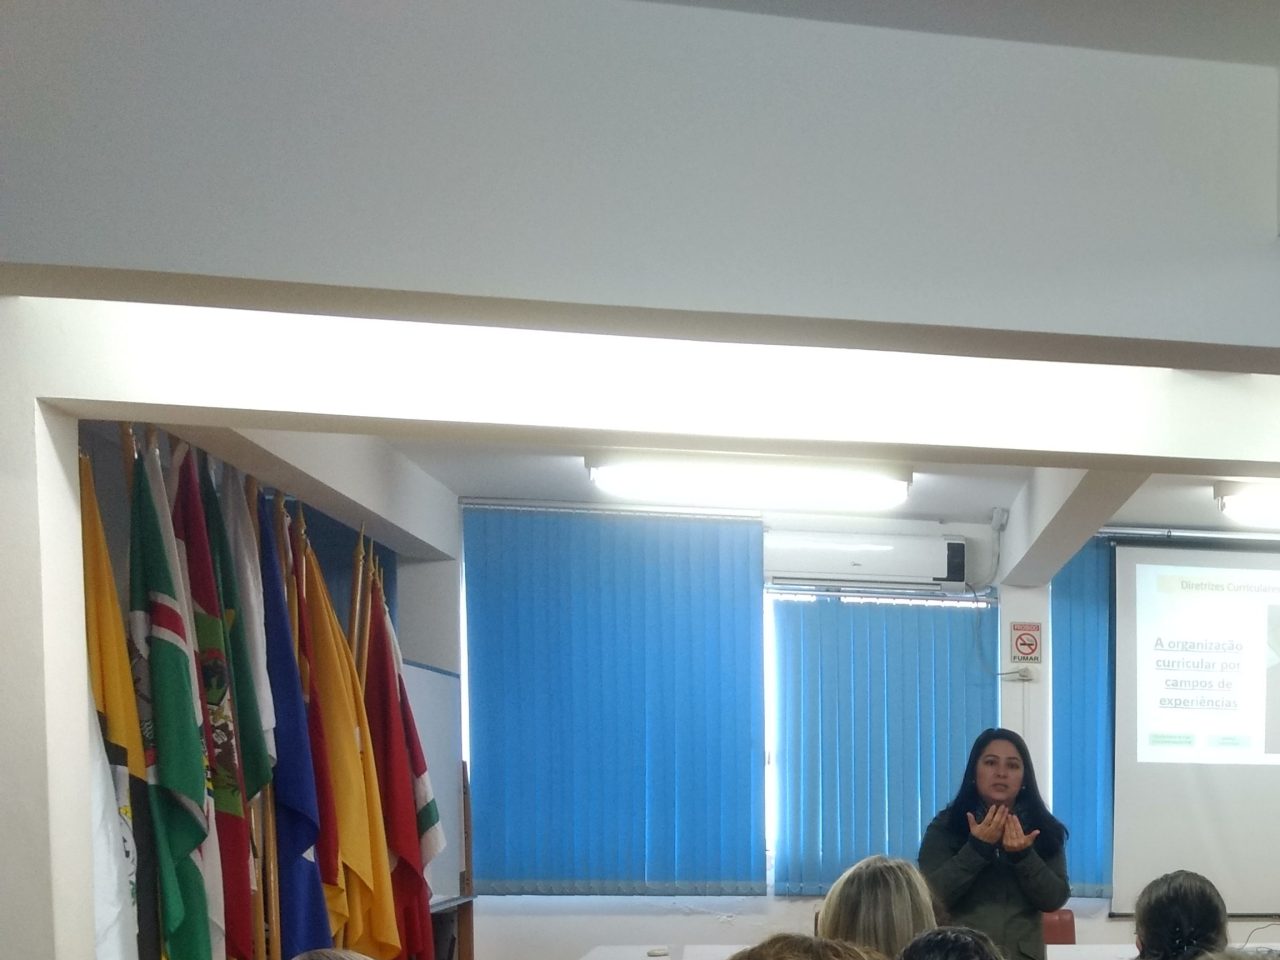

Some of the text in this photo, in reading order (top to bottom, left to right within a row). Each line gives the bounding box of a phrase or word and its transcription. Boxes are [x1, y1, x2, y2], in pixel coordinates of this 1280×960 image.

[1180, 579, 1225, 591] Diretrizes
[1227, 582, 1280, 593] Curriculares
[1154, 636, 1243, 652] A organização
[1155, 657, 1240, 672] curricular por
[1165, 678, 1233, 690] campos de
[1159, 695, 1239, 709] experiências
